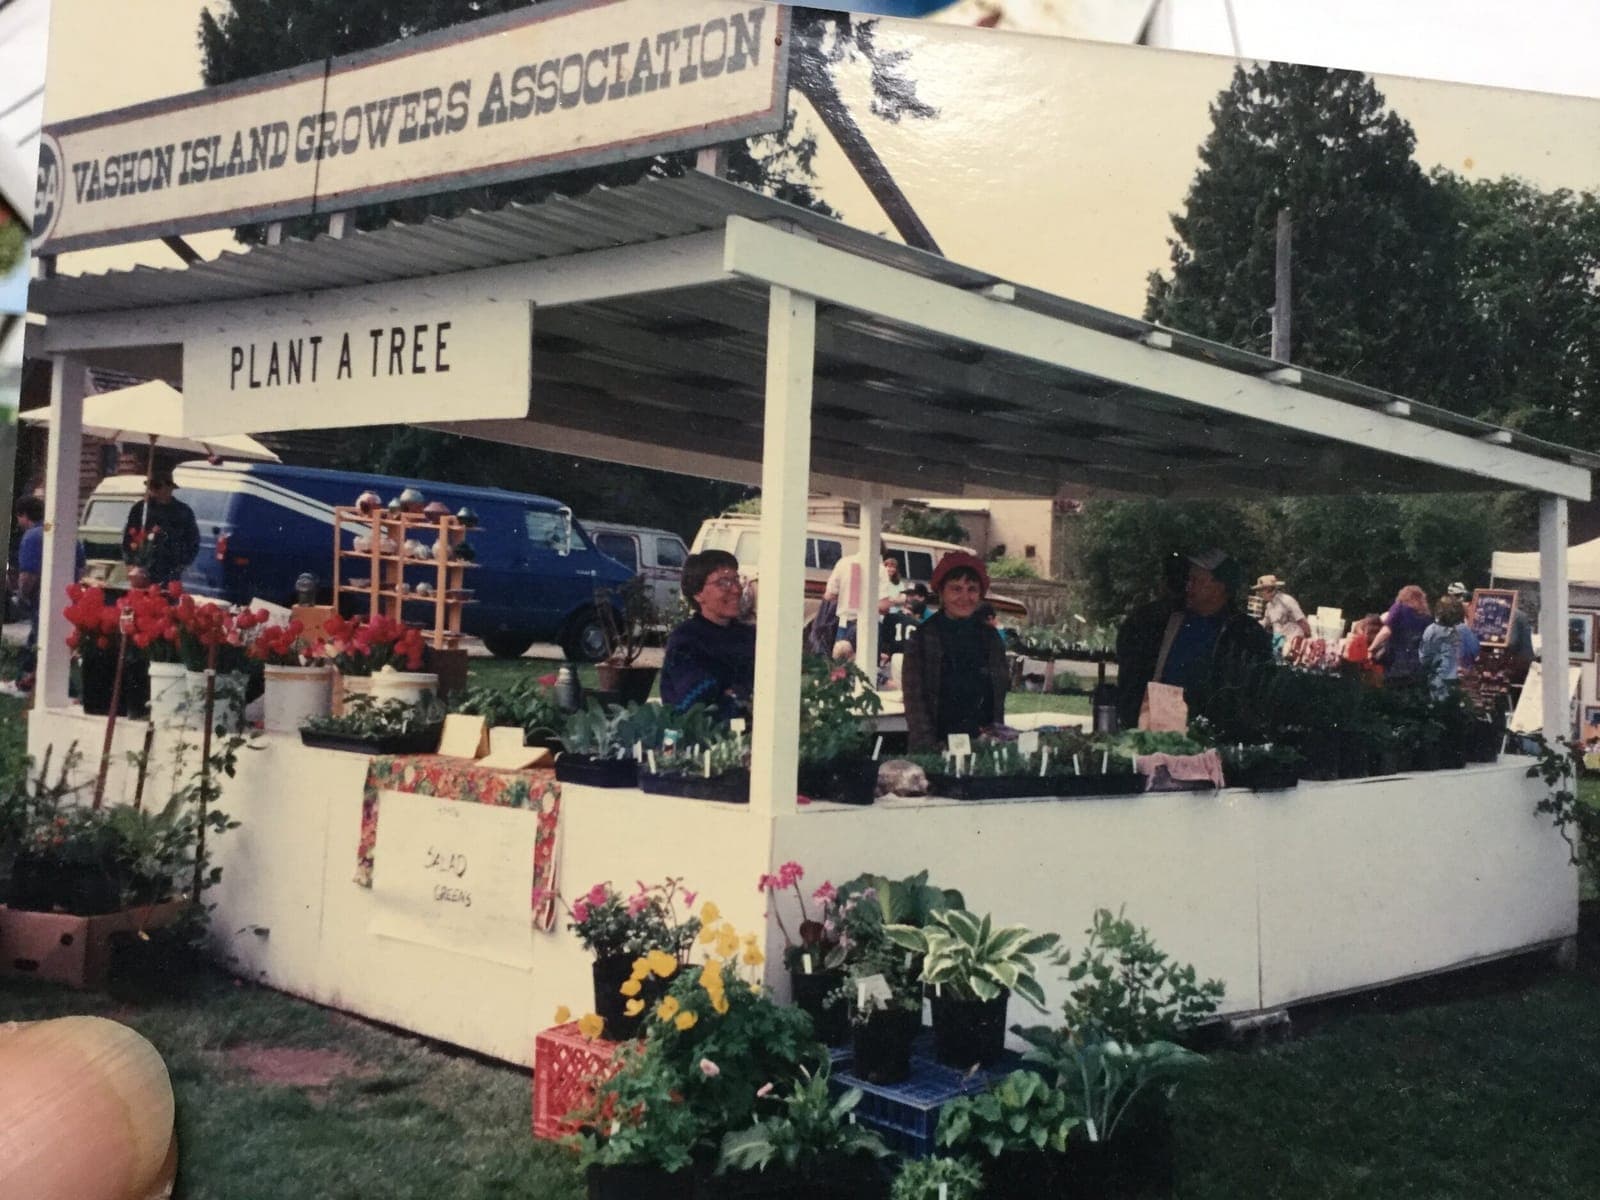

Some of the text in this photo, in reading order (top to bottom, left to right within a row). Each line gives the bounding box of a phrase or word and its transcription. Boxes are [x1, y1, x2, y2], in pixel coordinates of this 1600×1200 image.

[72, 8, 766, 205] VASHON ISLAND GROWERS ASSOCIATION
[230, 321, 451, 390] PLANT A TREE
